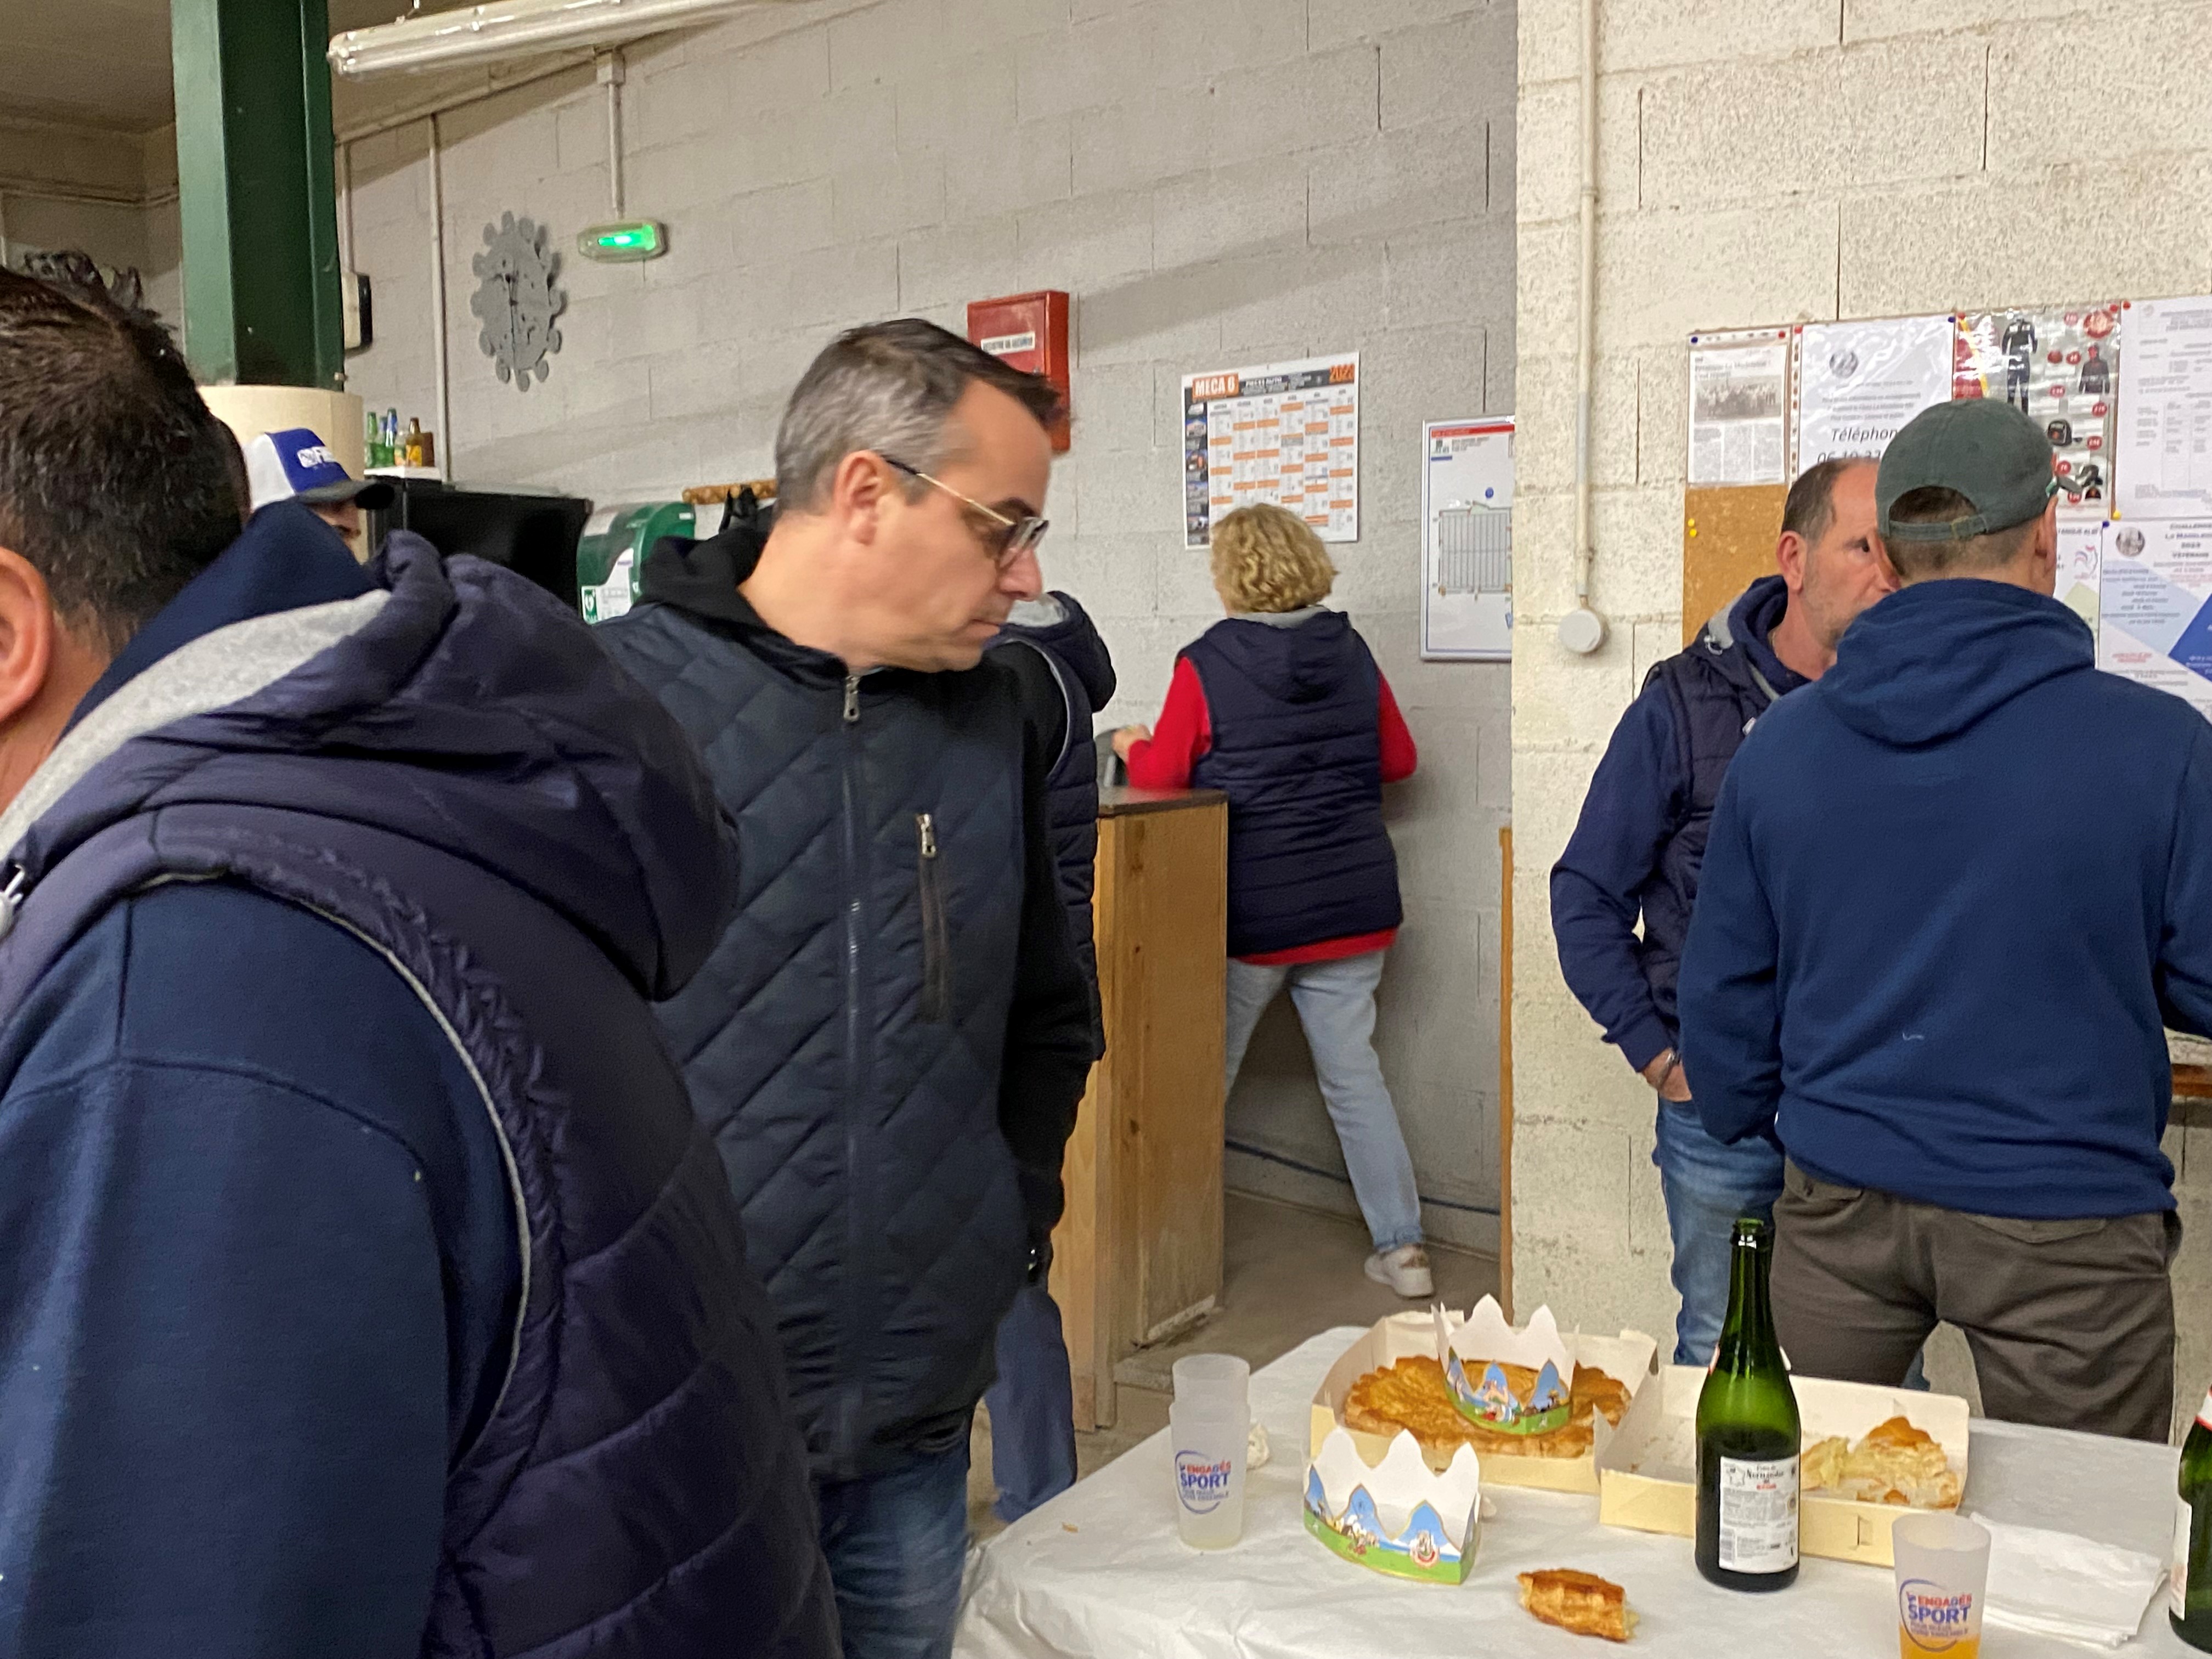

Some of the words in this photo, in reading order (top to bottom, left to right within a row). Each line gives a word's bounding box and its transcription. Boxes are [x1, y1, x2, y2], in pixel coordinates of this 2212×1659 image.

[1831, 426, 1897, 444] Téléphon
[1180, 1472, 1231, 1489] SPORT
[1908, 1604, 1972, 1623] SPORT
